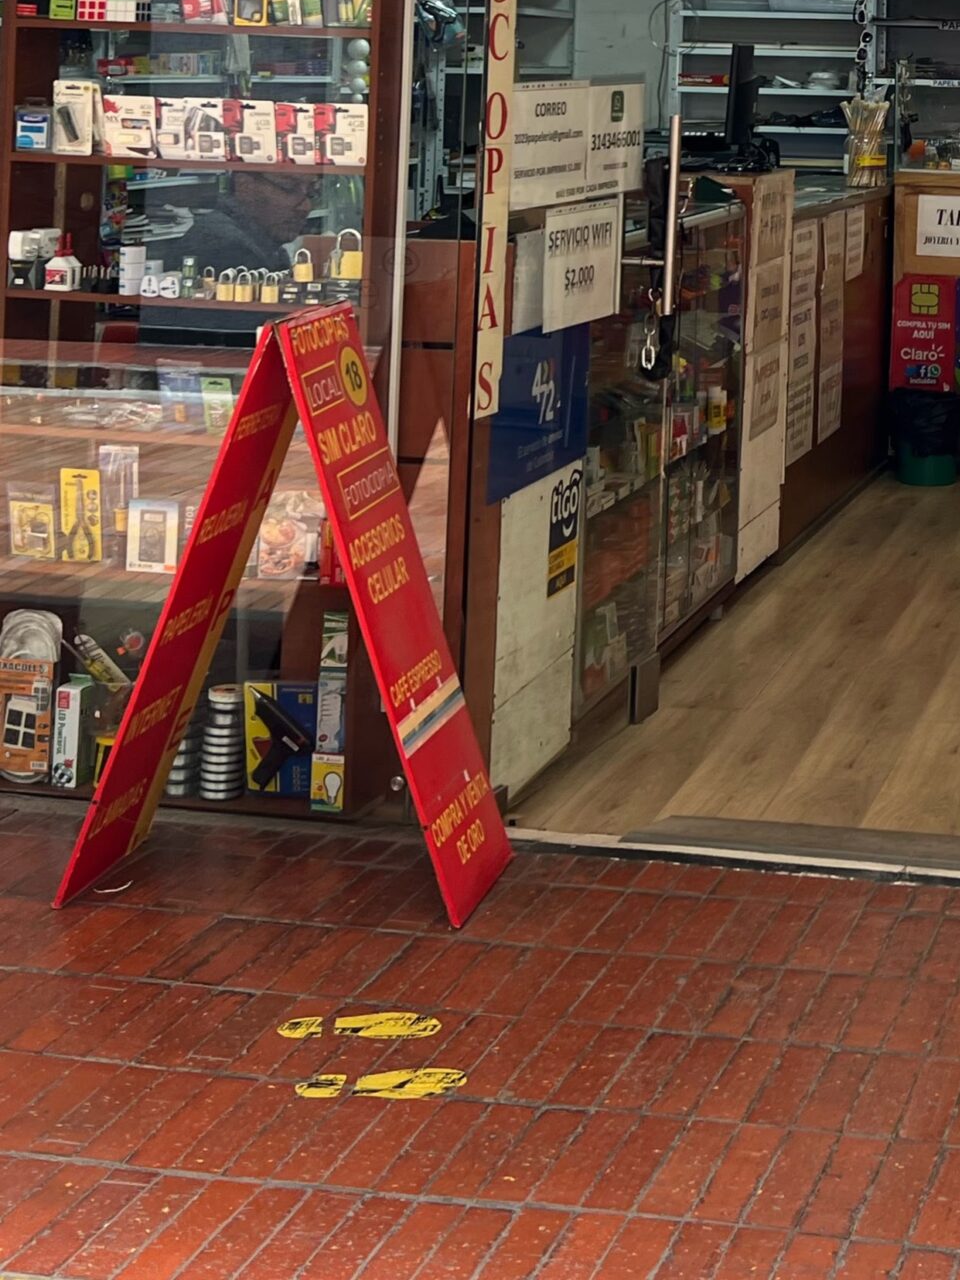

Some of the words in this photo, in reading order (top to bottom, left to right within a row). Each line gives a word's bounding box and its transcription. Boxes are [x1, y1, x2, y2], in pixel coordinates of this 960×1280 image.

[535, 101, 567, 118] CORREO
[548, 225, 590, 250] SERVICIO
[592, 221, 613, 242] WIFI
[565, 264, 595, 291] $2.000
[291, 315, 350, 358] FOTOCOPIAS
[896, 320, 927, 329] COMPRA
[927, 321, 937, 329] TU
[937, 322, 951, 330] SIM
[900, 347, 938, 361] Claro
[307, 373, 343, 409] LOCAL
[345, 360, 363, 393] 18
[317, 425, 343, 466] SIM
[342, 411, 377, 456] CLARO
[344, 463, 399, 509] FOTOCOPIA
[349, 514, 405, 570] ACCESORIOS
[367, 556, 410, 605] CELULAR
[406, 649, 442, 693] ESPRESSO
[431, 803, 465, 848] COMPRA
[463, 770, 490, 810] VENTA
[456, 834, 472, 866] DE
[466, 818, 486, 853] ORO
